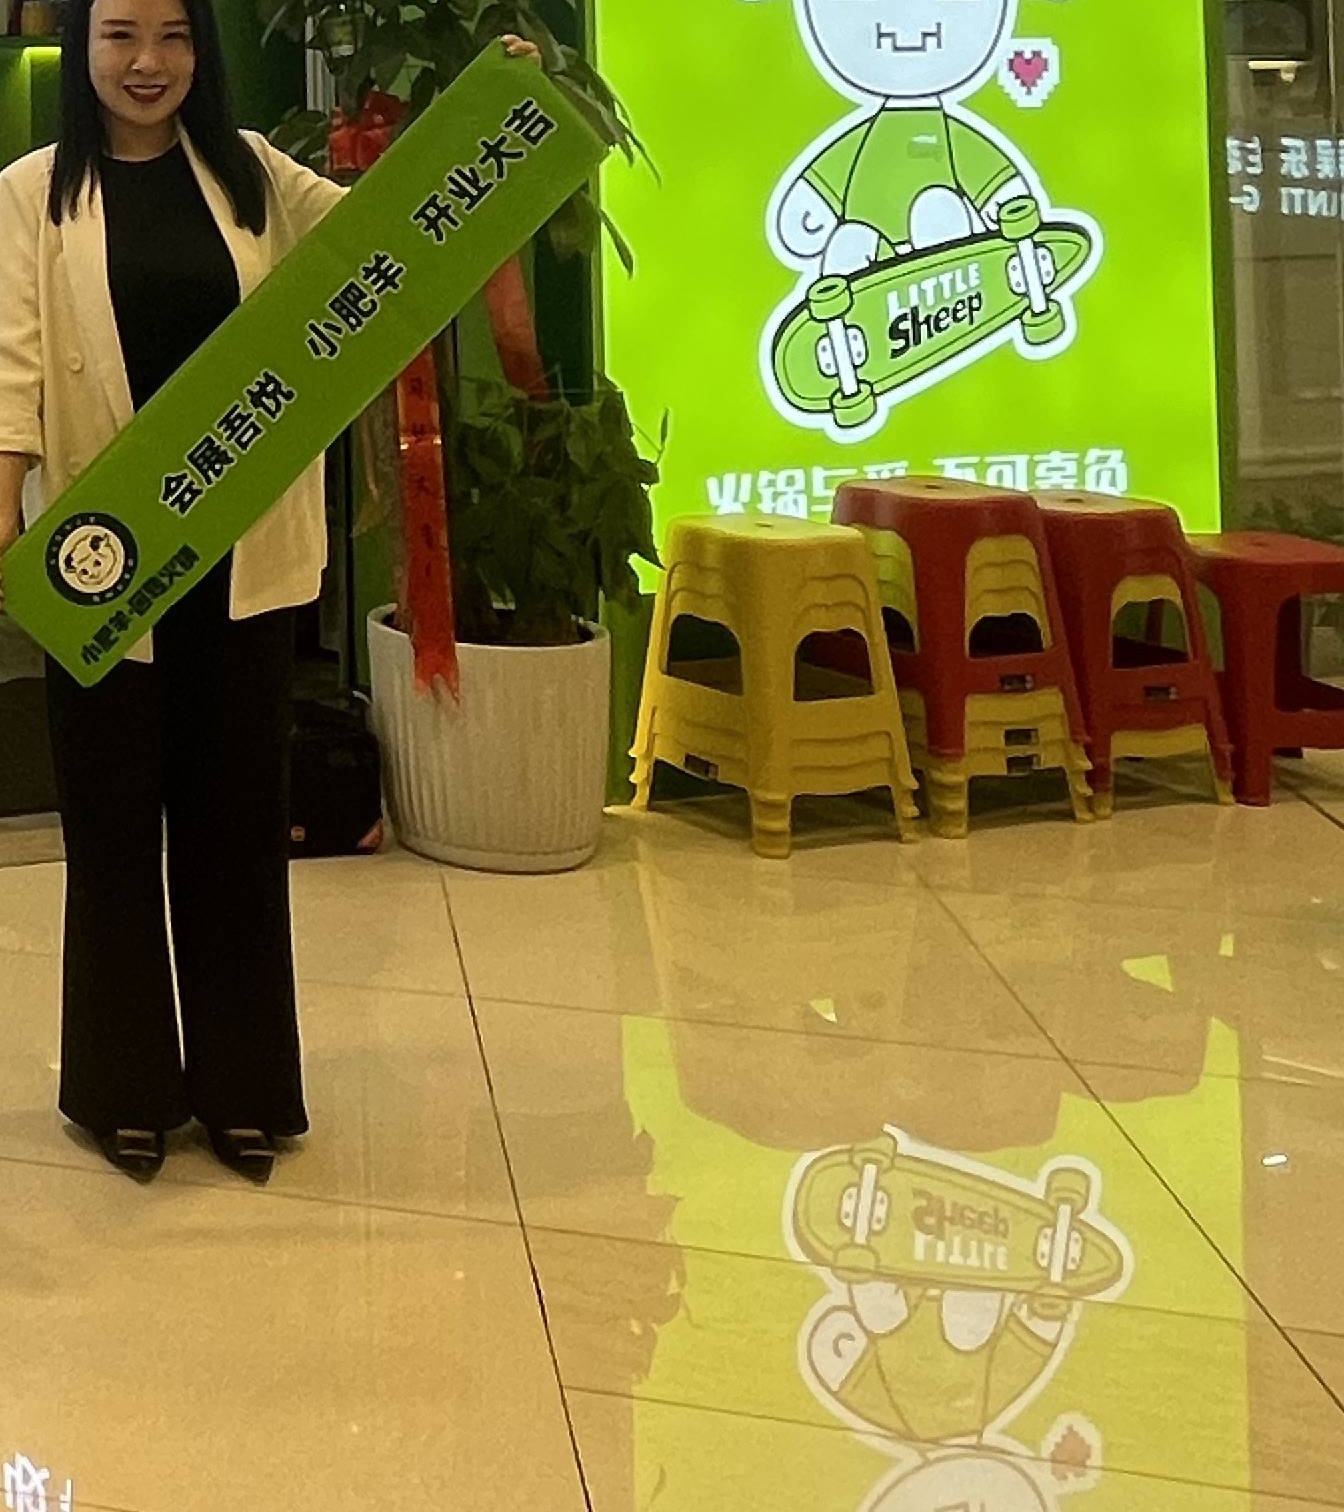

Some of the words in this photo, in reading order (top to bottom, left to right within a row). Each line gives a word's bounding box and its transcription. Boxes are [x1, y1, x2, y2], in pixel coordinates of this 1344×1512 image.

[159, 368, 298, 519] 会展吾悦
[303, 250, 409, 362] 小肥羊
[411, 96, 559, 245] 开业大吉
[887, 262, 981, 322] LITTLE
[889, 291, 983, 360] Sheep
